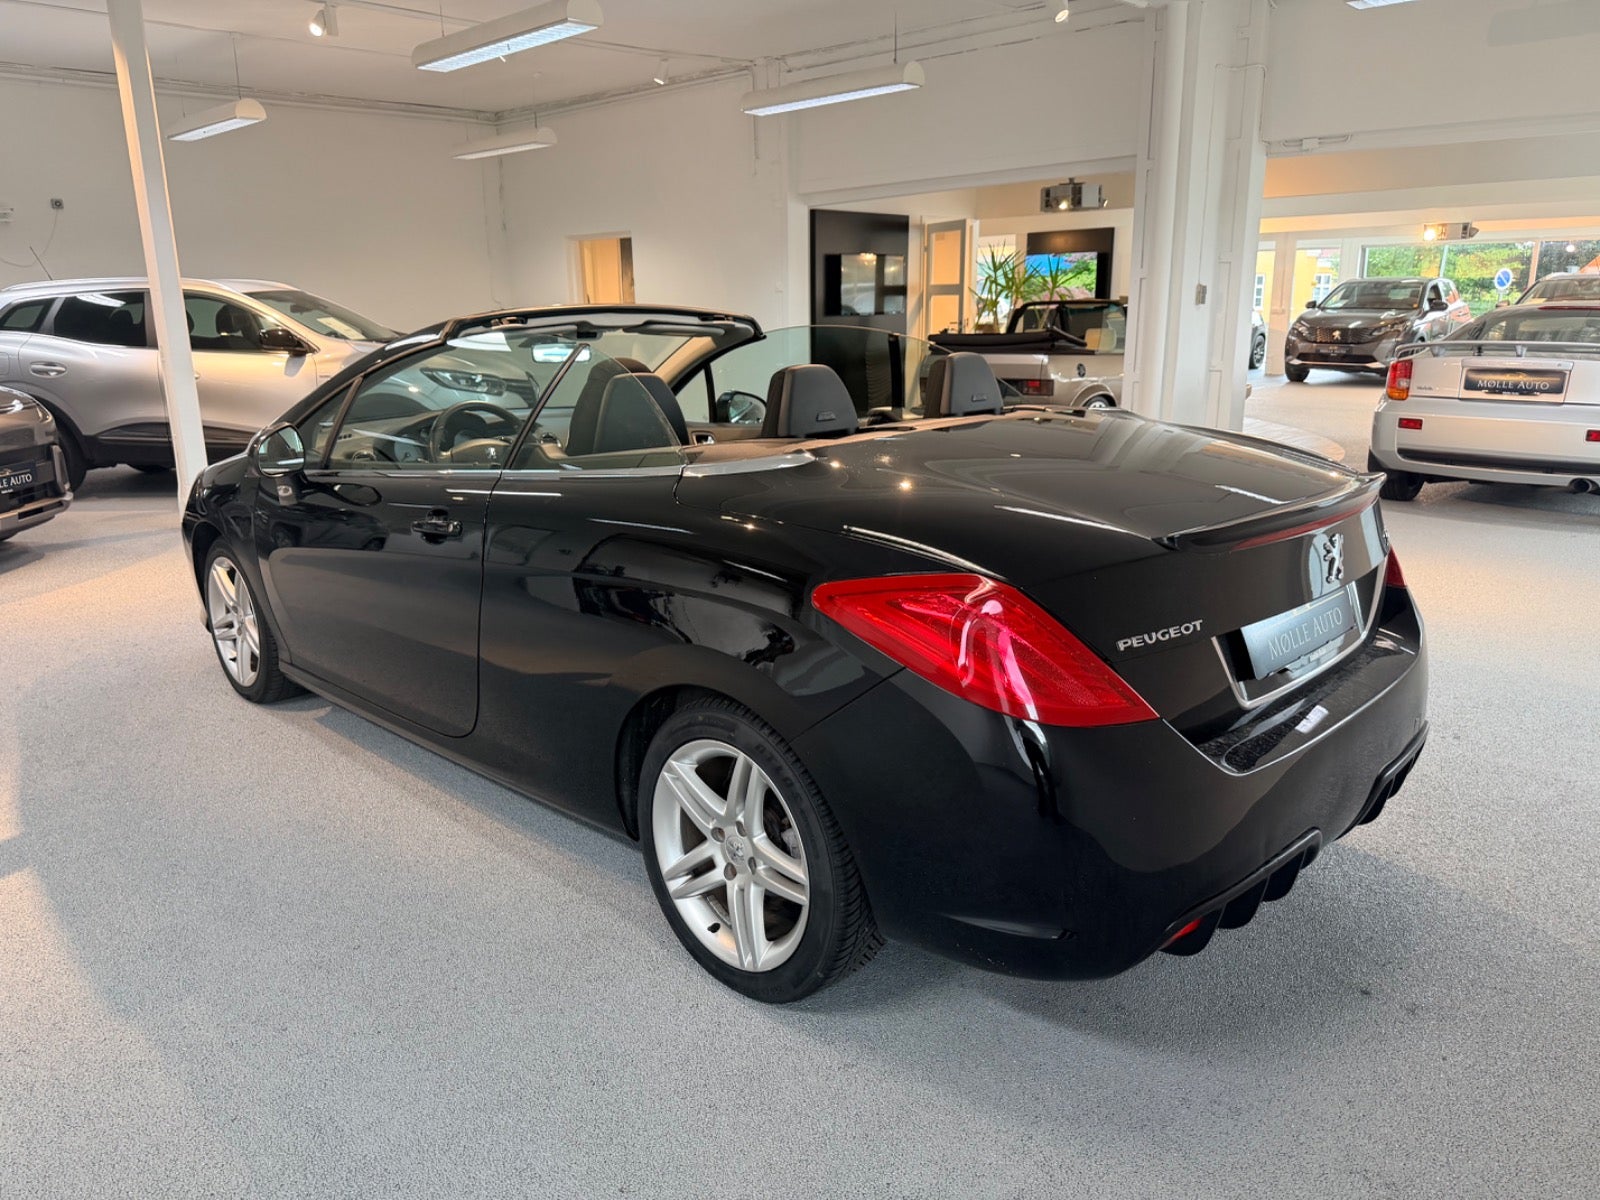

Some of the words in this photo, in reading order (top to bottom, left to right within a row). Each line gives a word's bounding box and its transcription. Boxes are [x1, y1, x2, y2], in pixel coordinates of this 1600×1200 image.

[1477, 379, 1514, 390] MØLLE
[1517, 380, 1550, 390] AUTO
[10, 473, 33, 486] AUTO
[1116, 619, 1203, 652] PEUGEOT
[1267, 621, 1312, 661] MØLLE
[1313, 606, 1343, 638] AUTO
